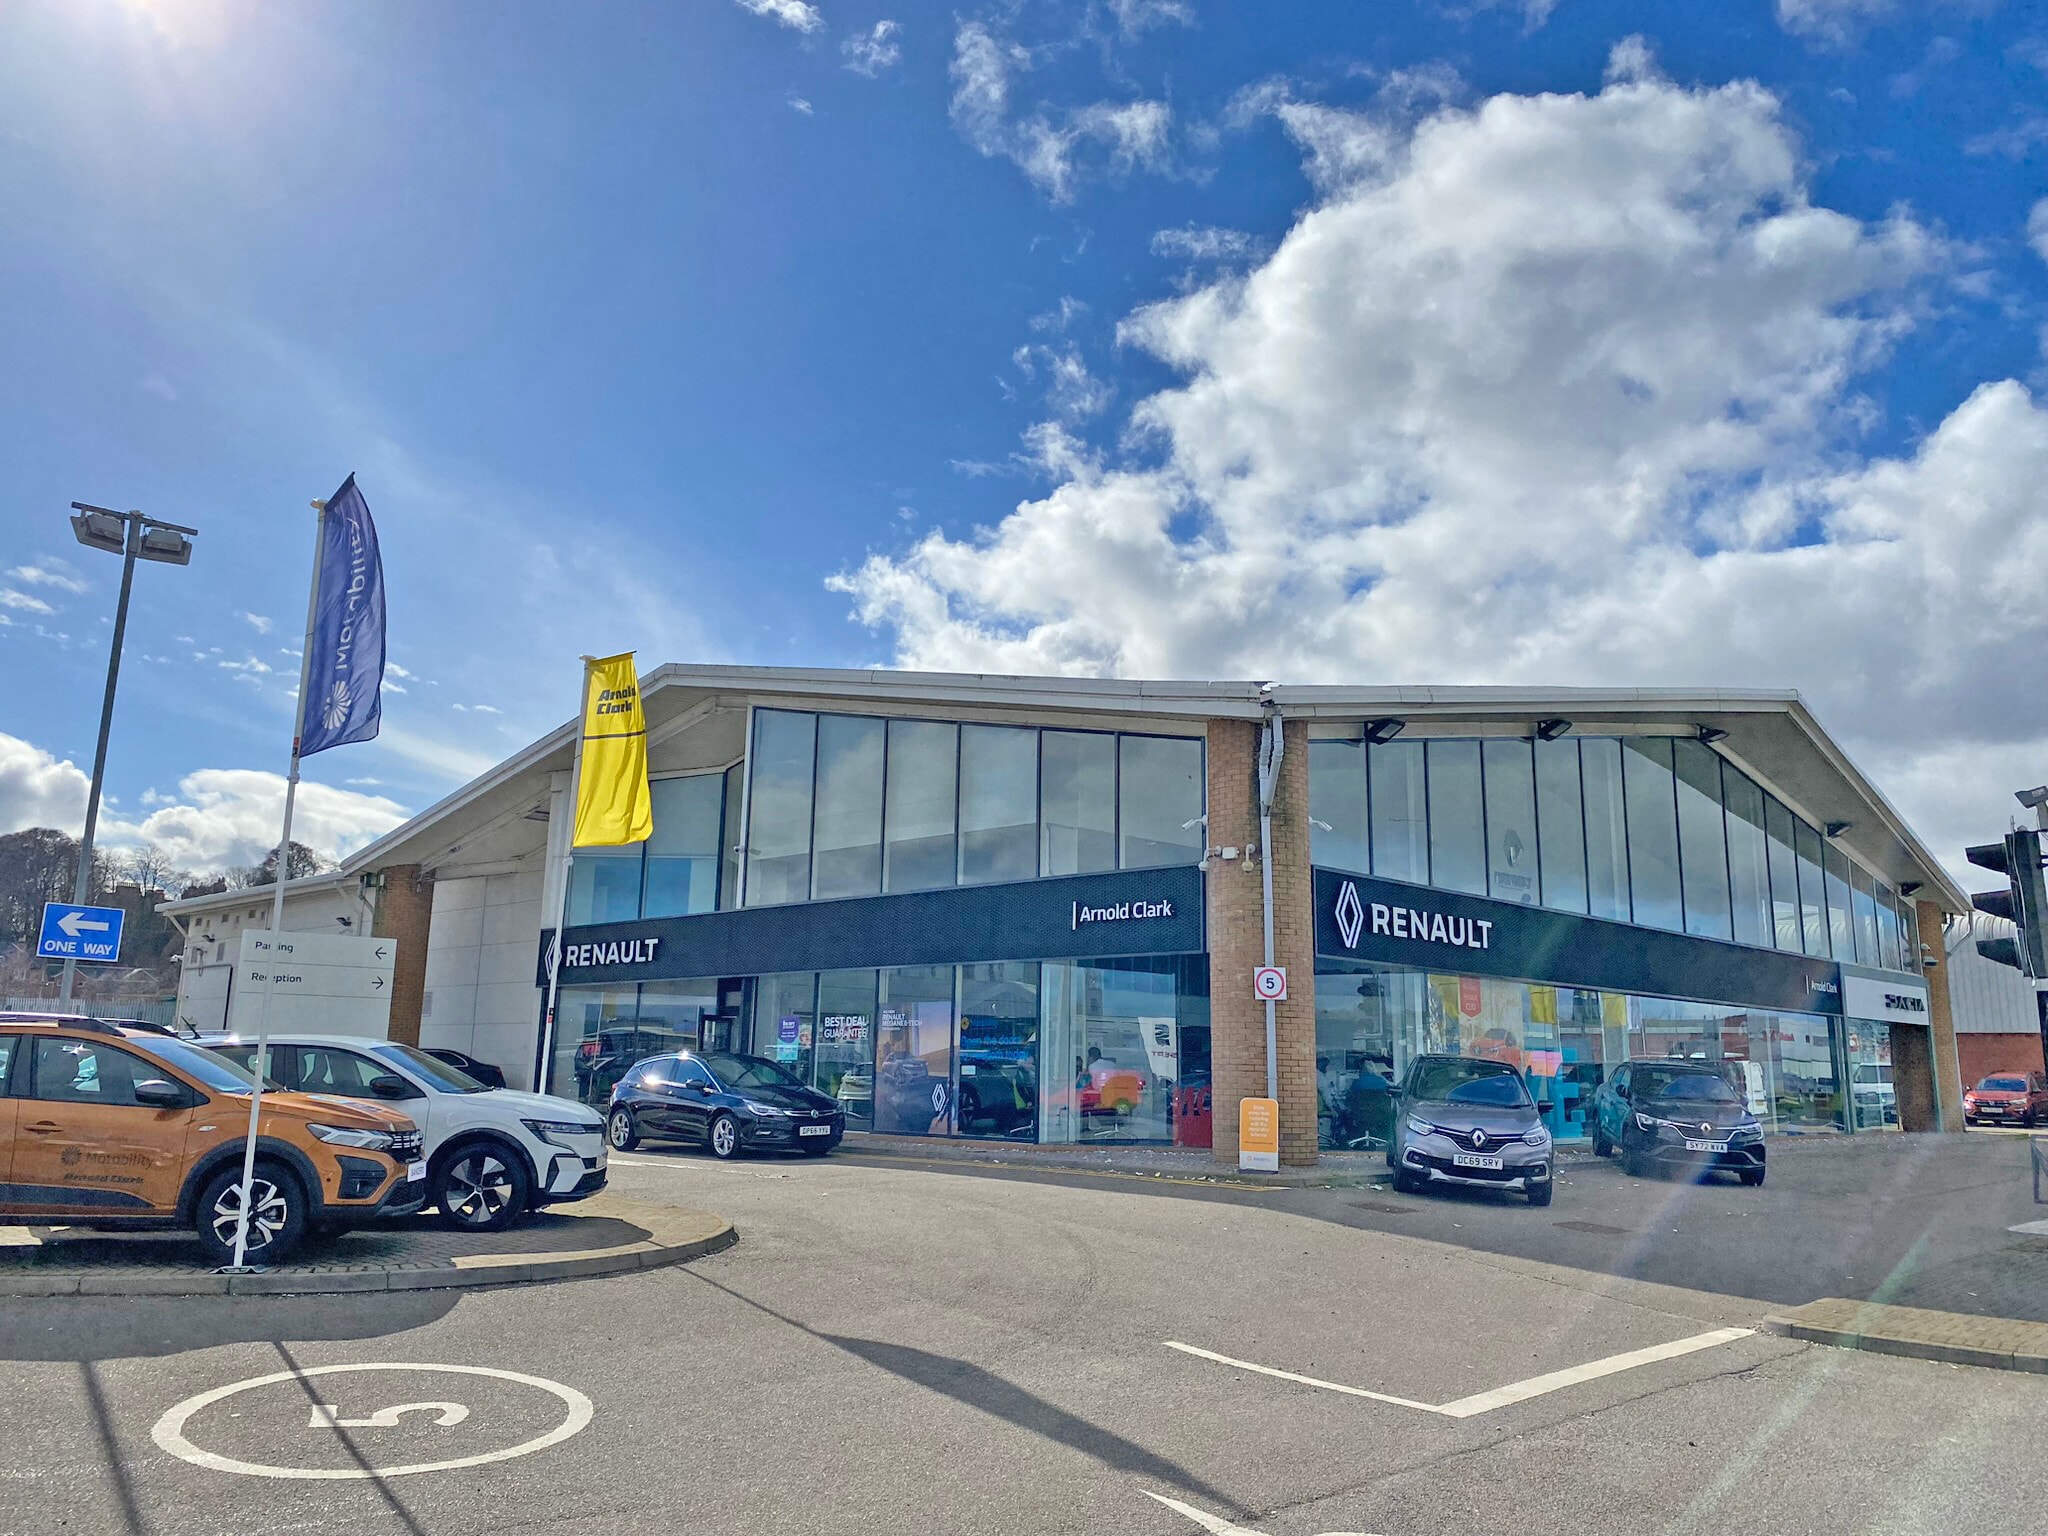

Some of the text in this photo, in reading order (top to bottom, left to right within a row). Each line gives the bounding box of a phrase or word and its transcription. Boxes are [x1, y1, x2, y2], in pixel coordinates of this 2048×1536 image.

[1079, 899, 1173, 922] Arnold Clark
[1370, 902, 1493, 949] RENAULT
[44, 940, 114, 955] ONE WAY
[255, 941, 294, 954] Paring
[565, 938, 659, 967] RENAULT
[251, 972, 302, 984] Reption
[1266, 977, 1275, 990] 5
[824, 1015, 866, 1027] BEST DEAL
[1457, 1155, 1500, 1168] DC69 SRY
[308, 1401, 470, 1428] 5
